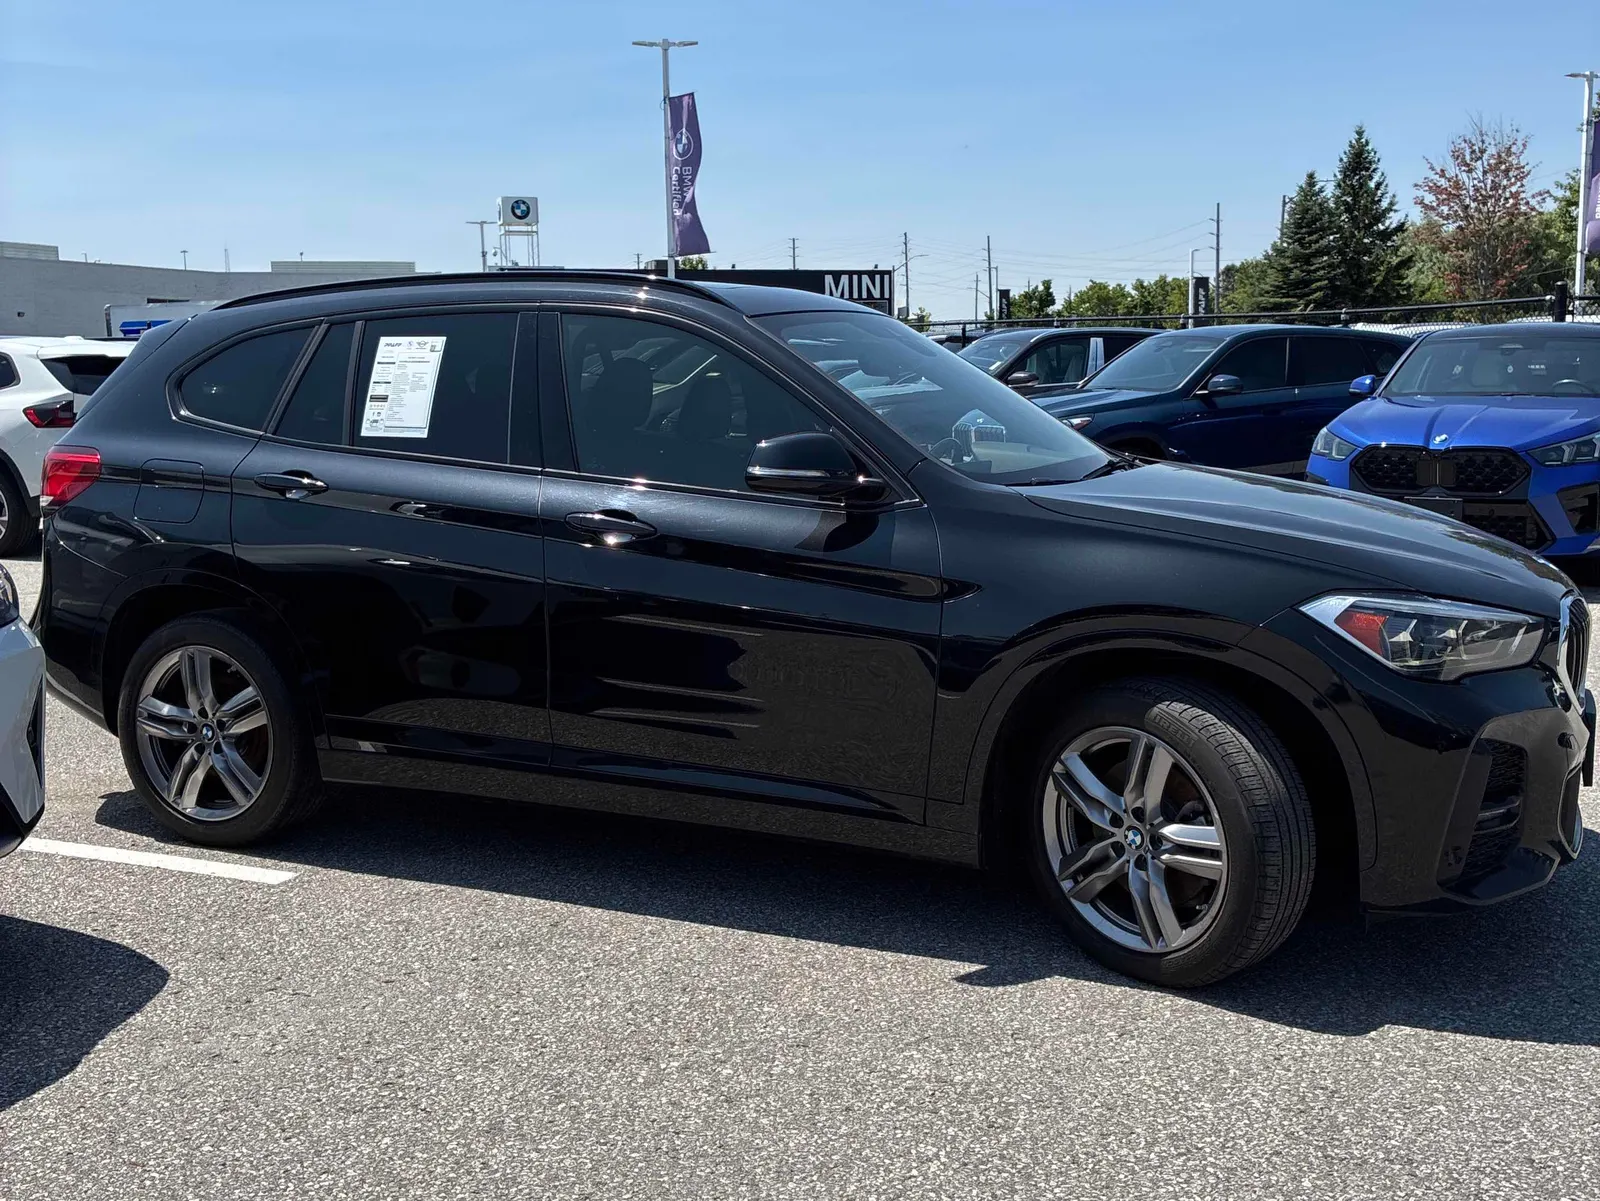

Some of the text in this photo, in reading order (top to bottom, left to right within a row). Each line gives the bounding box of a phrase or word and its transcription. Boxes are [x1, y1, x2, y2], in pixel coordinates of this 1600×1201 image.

[672, 166, 682, 216] Certified
[682, 166, 692, 197] BMW
[824, 274, 890, 299] MINI
